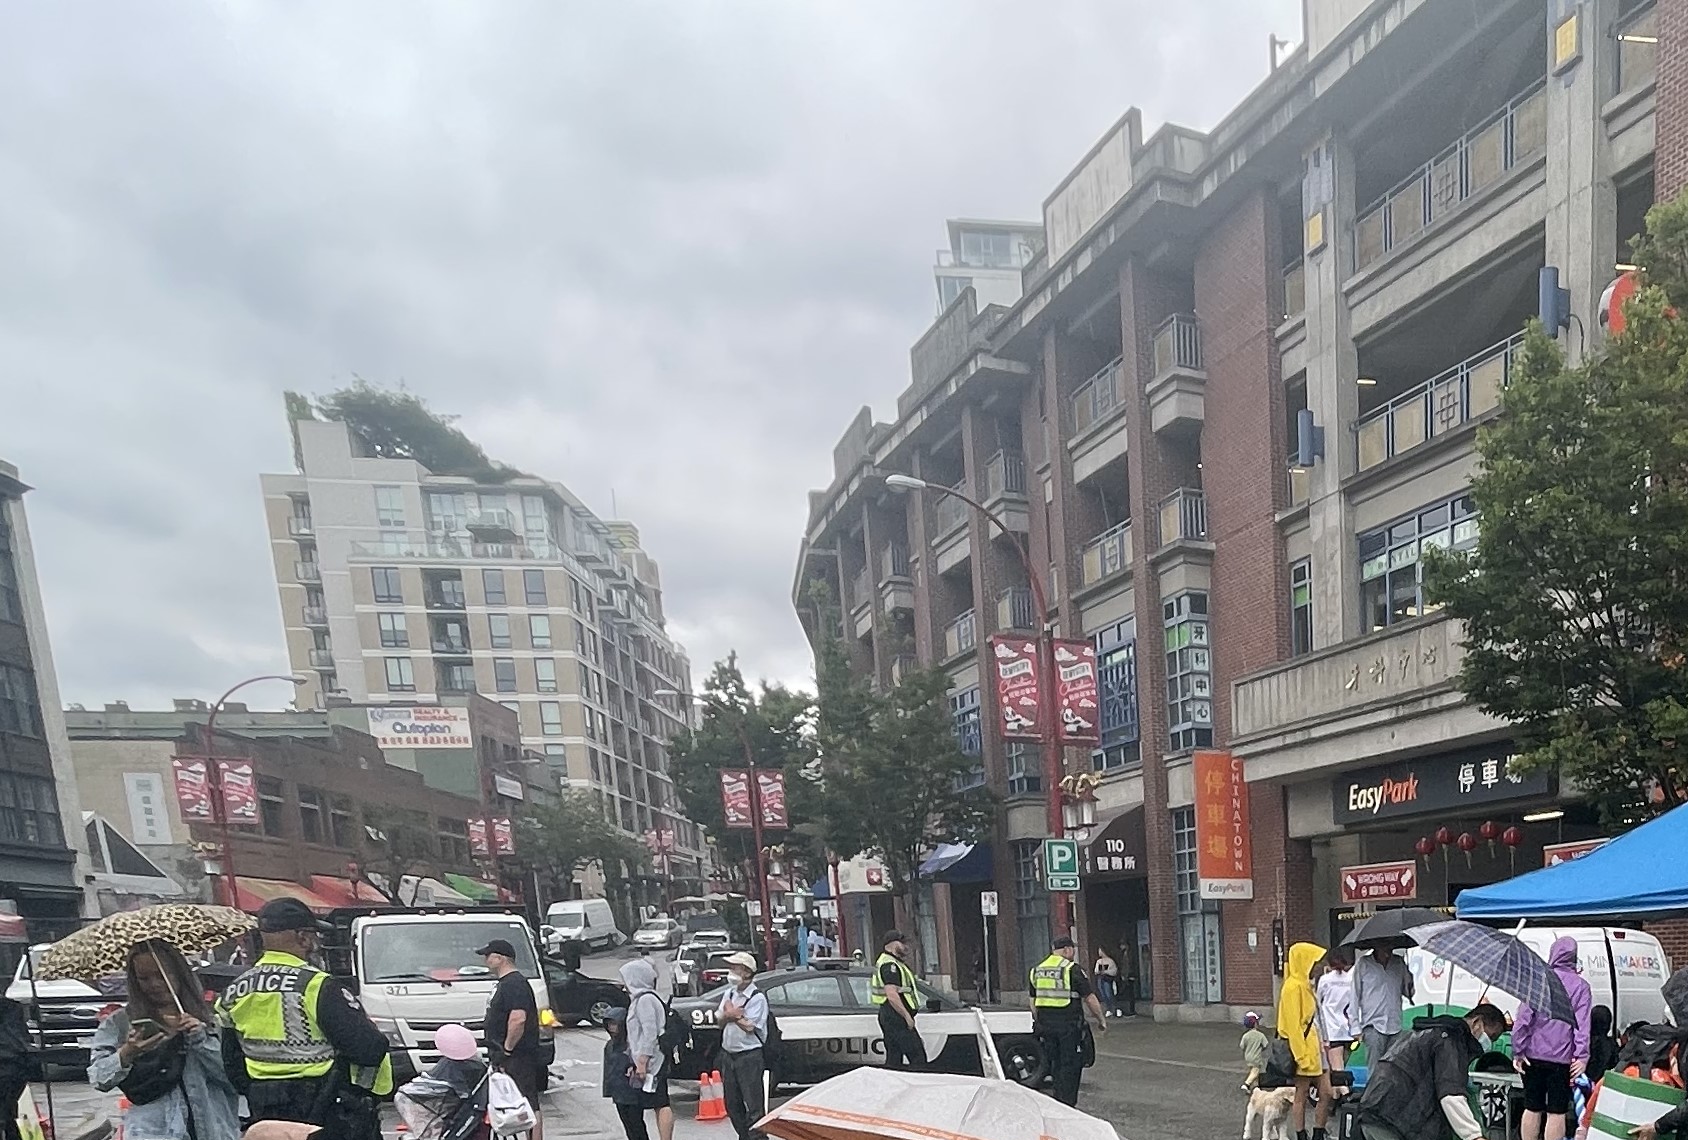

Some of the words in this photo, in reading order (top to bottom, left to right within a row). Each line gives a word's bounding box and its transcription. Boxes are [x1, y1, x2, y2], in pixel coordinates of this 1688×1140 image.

[1348, 771, 1420, 814] EasyPark
[1230, 759, 1244, 871] CHINATOWN
[1051, 844, 1072, 870] P
[1105, 839, 1125, 853] 110
[1208, 882, 1246, 894] EasyPark
[224, 974, 299, 1002] POLICE
[386, 985, 409, 995] 371
[805, 1036, 885, 1056] POLIC
